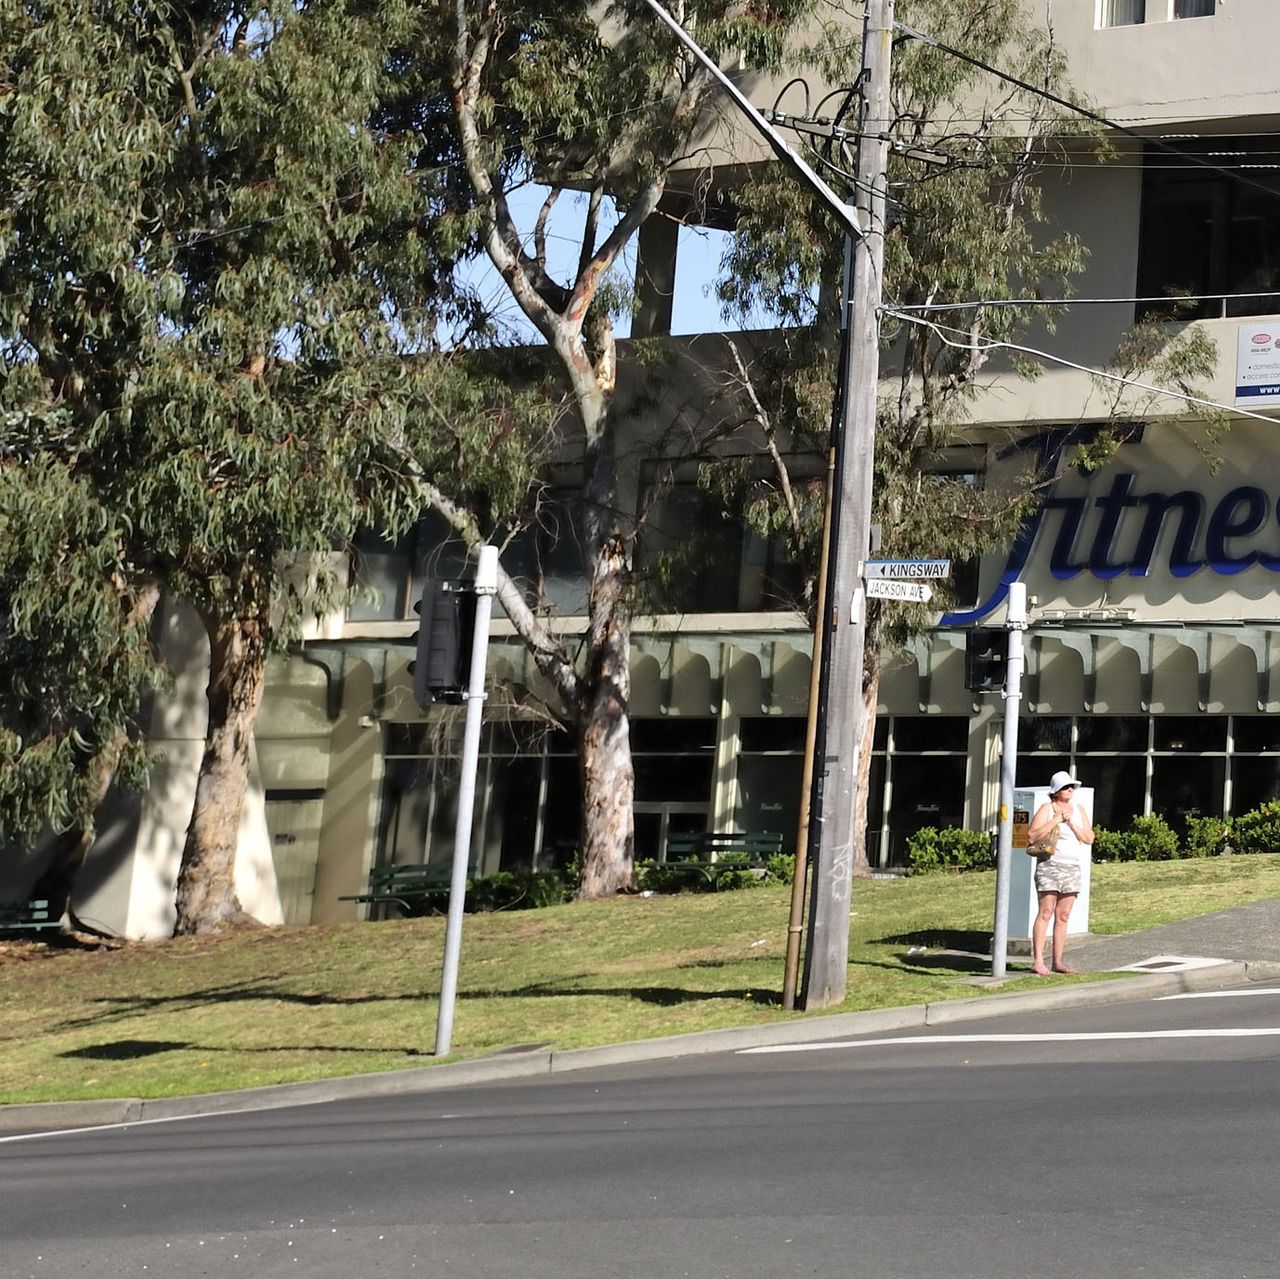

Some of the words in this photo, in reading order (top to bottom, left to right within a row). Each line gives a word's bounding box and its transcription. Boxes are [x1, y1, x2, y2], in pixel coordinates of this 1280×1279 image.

[889, 564, 946, 577] KINGSWAY
[869, 581, 907, 597] JACKSON
[910, 585, 924, 598] AVE
